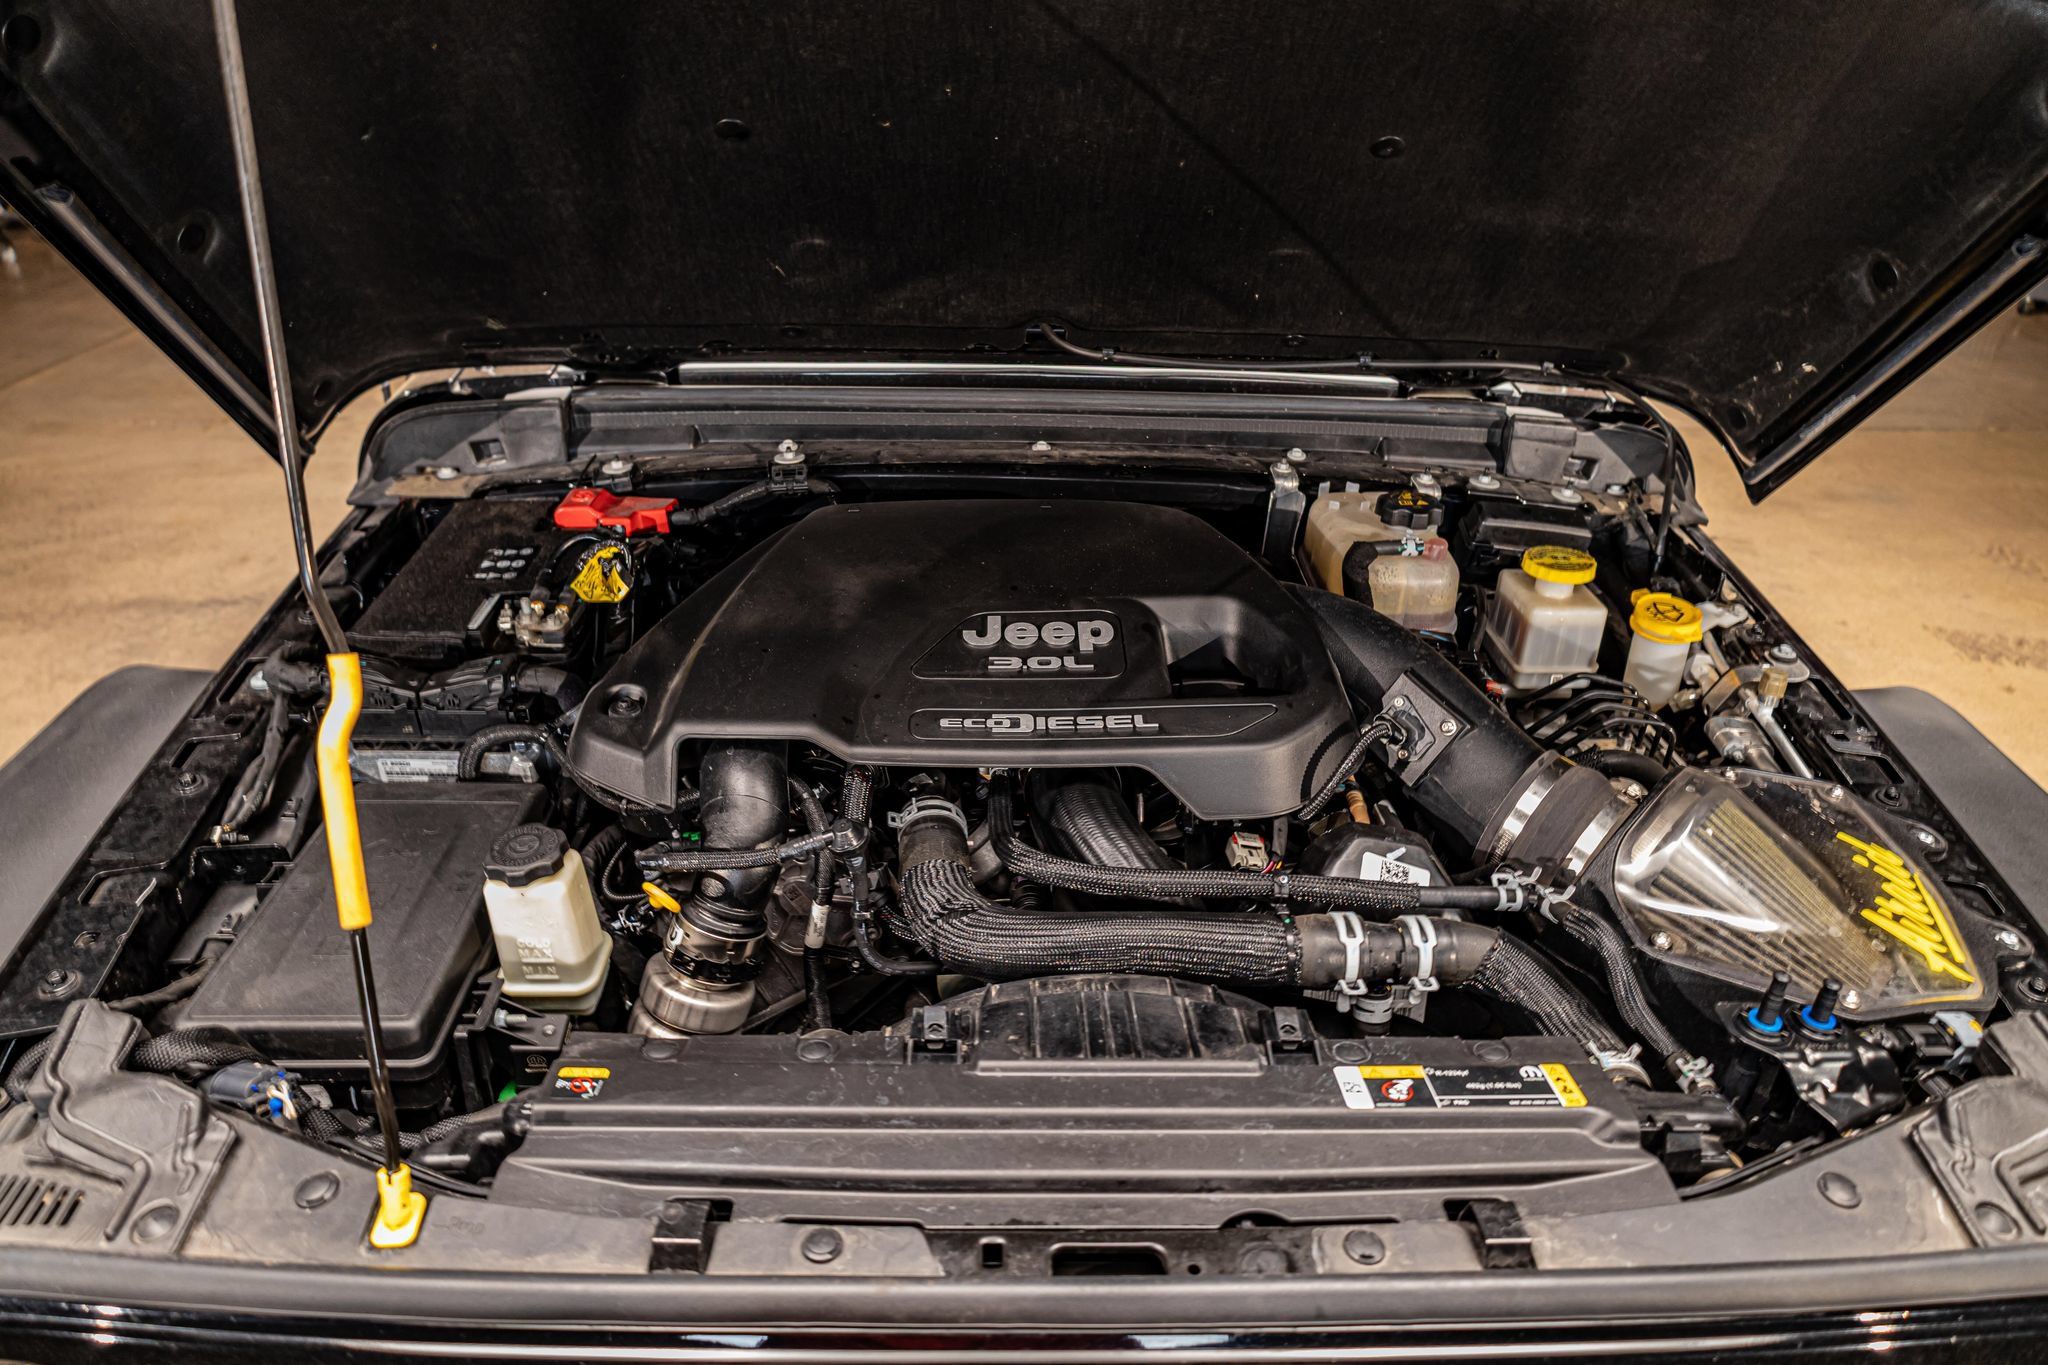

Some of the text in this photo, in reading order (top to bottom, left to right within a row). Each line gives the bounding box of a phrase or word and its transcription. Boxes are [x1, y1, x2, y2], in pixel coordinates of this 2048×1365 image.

[962, 615, 1115, 653] Jeep
[987, 656, 1095, 672] 3.0L
[518, 948, 554, 958] MAX
[522, 965, 557, 975] MIN
